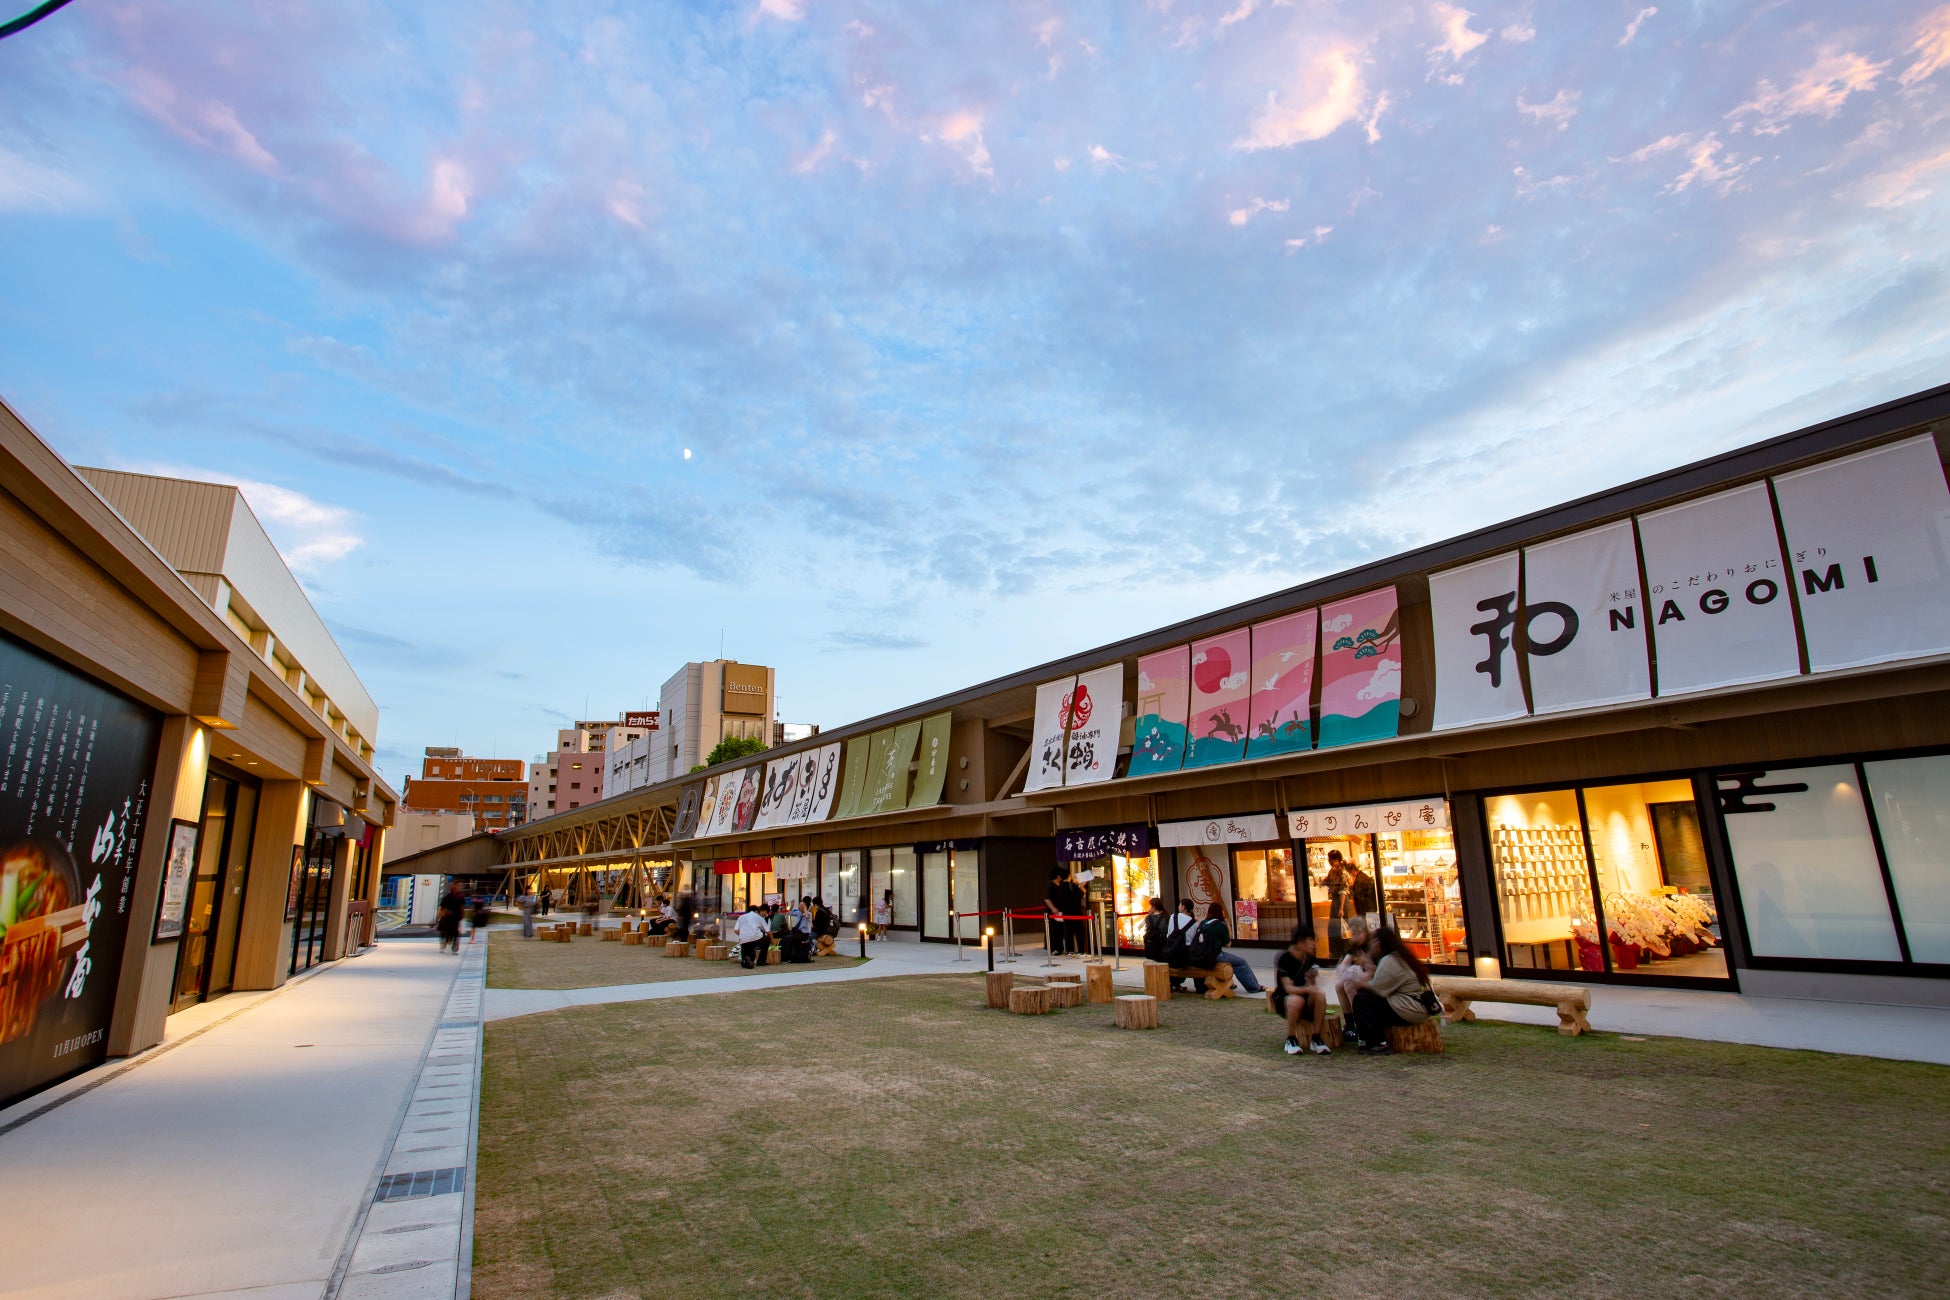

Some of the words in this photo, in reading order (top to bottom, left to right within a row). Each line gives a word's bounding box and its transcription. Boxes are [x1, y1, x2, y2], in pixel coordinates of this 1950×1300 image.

[1609, 547, 1826, 602] 米屋のこだわりおにぎり
[1609, 555, 1879, 632] NAGOMI
[729, 681, 763, 693] Benten
[114, 795, 131, 866] 大久手
[117, 779, 147, 914] 大正十四年創業
[64, 810, 115, 999] 山本屋
[53, 1028, 104, 1058] 11月1日OPEN
